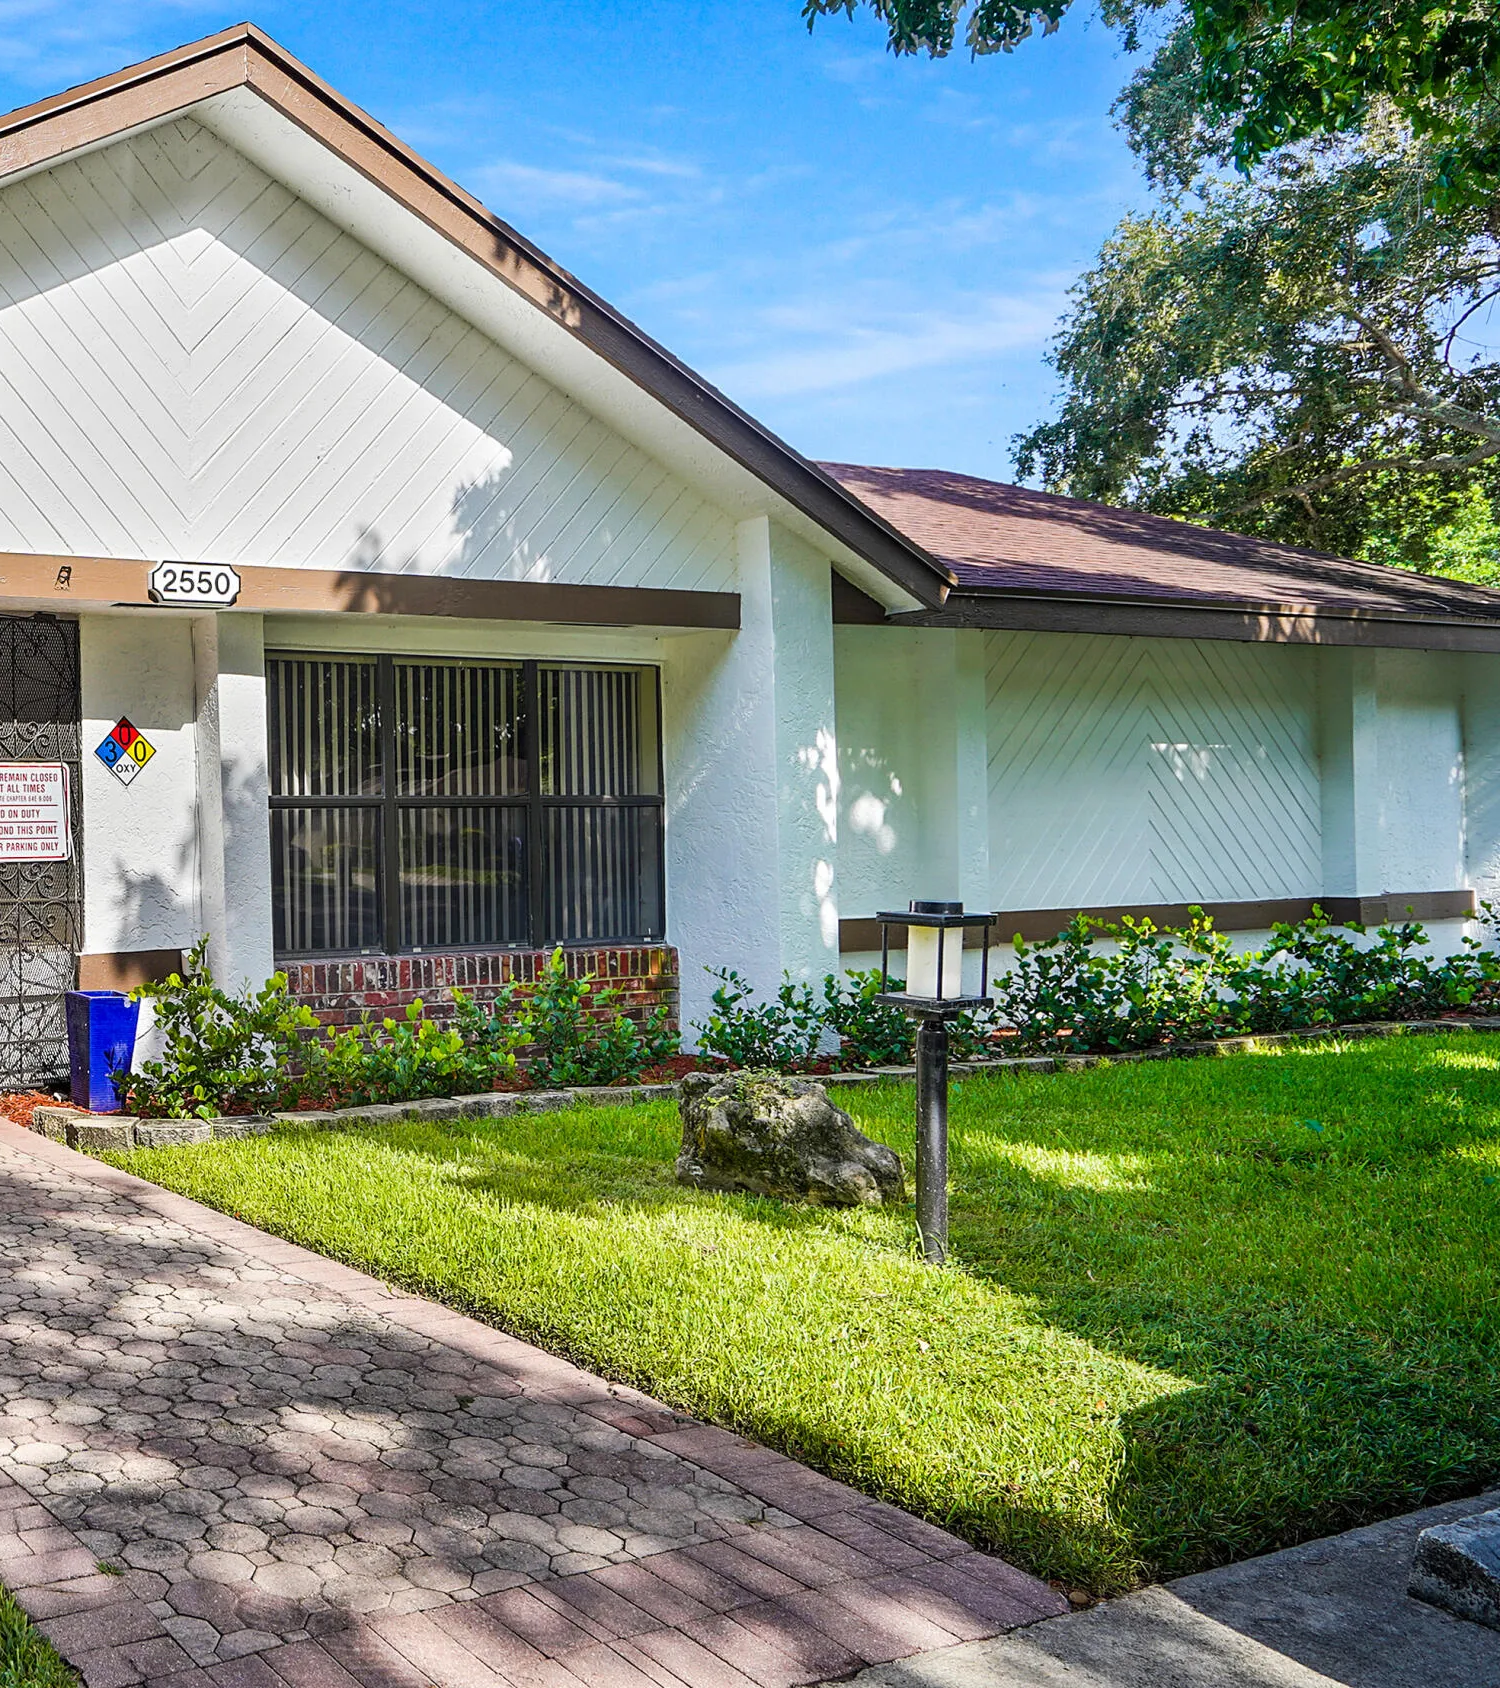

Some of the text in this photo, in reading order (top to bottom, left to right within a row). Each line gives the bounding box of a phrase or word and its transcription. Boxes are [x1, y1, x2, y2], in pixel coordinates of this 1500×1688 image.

[163, 569, 230, 595] 2550
[119, 724, 131, 745] 0
[105, 741, 117, 762] 3
[134, 741, 146, 762] 0
[116, 764, 136, 773] OXY
[0, 773, 27, 782] REMAIN
[30, 773, 58, 782] CLOSED
[7, 784, 20, 793] ALL
[23, 784, 45, 793] TIMES
[8, 809, 18, 818] ON
[21, 809, 40, 818] DUTY
[17, 826, 33, 835] THIS
[36, 826, 57, 835] POINT
[6, 842, 38, 851] PARKING
[41, 842, 58, 851] ONLY
